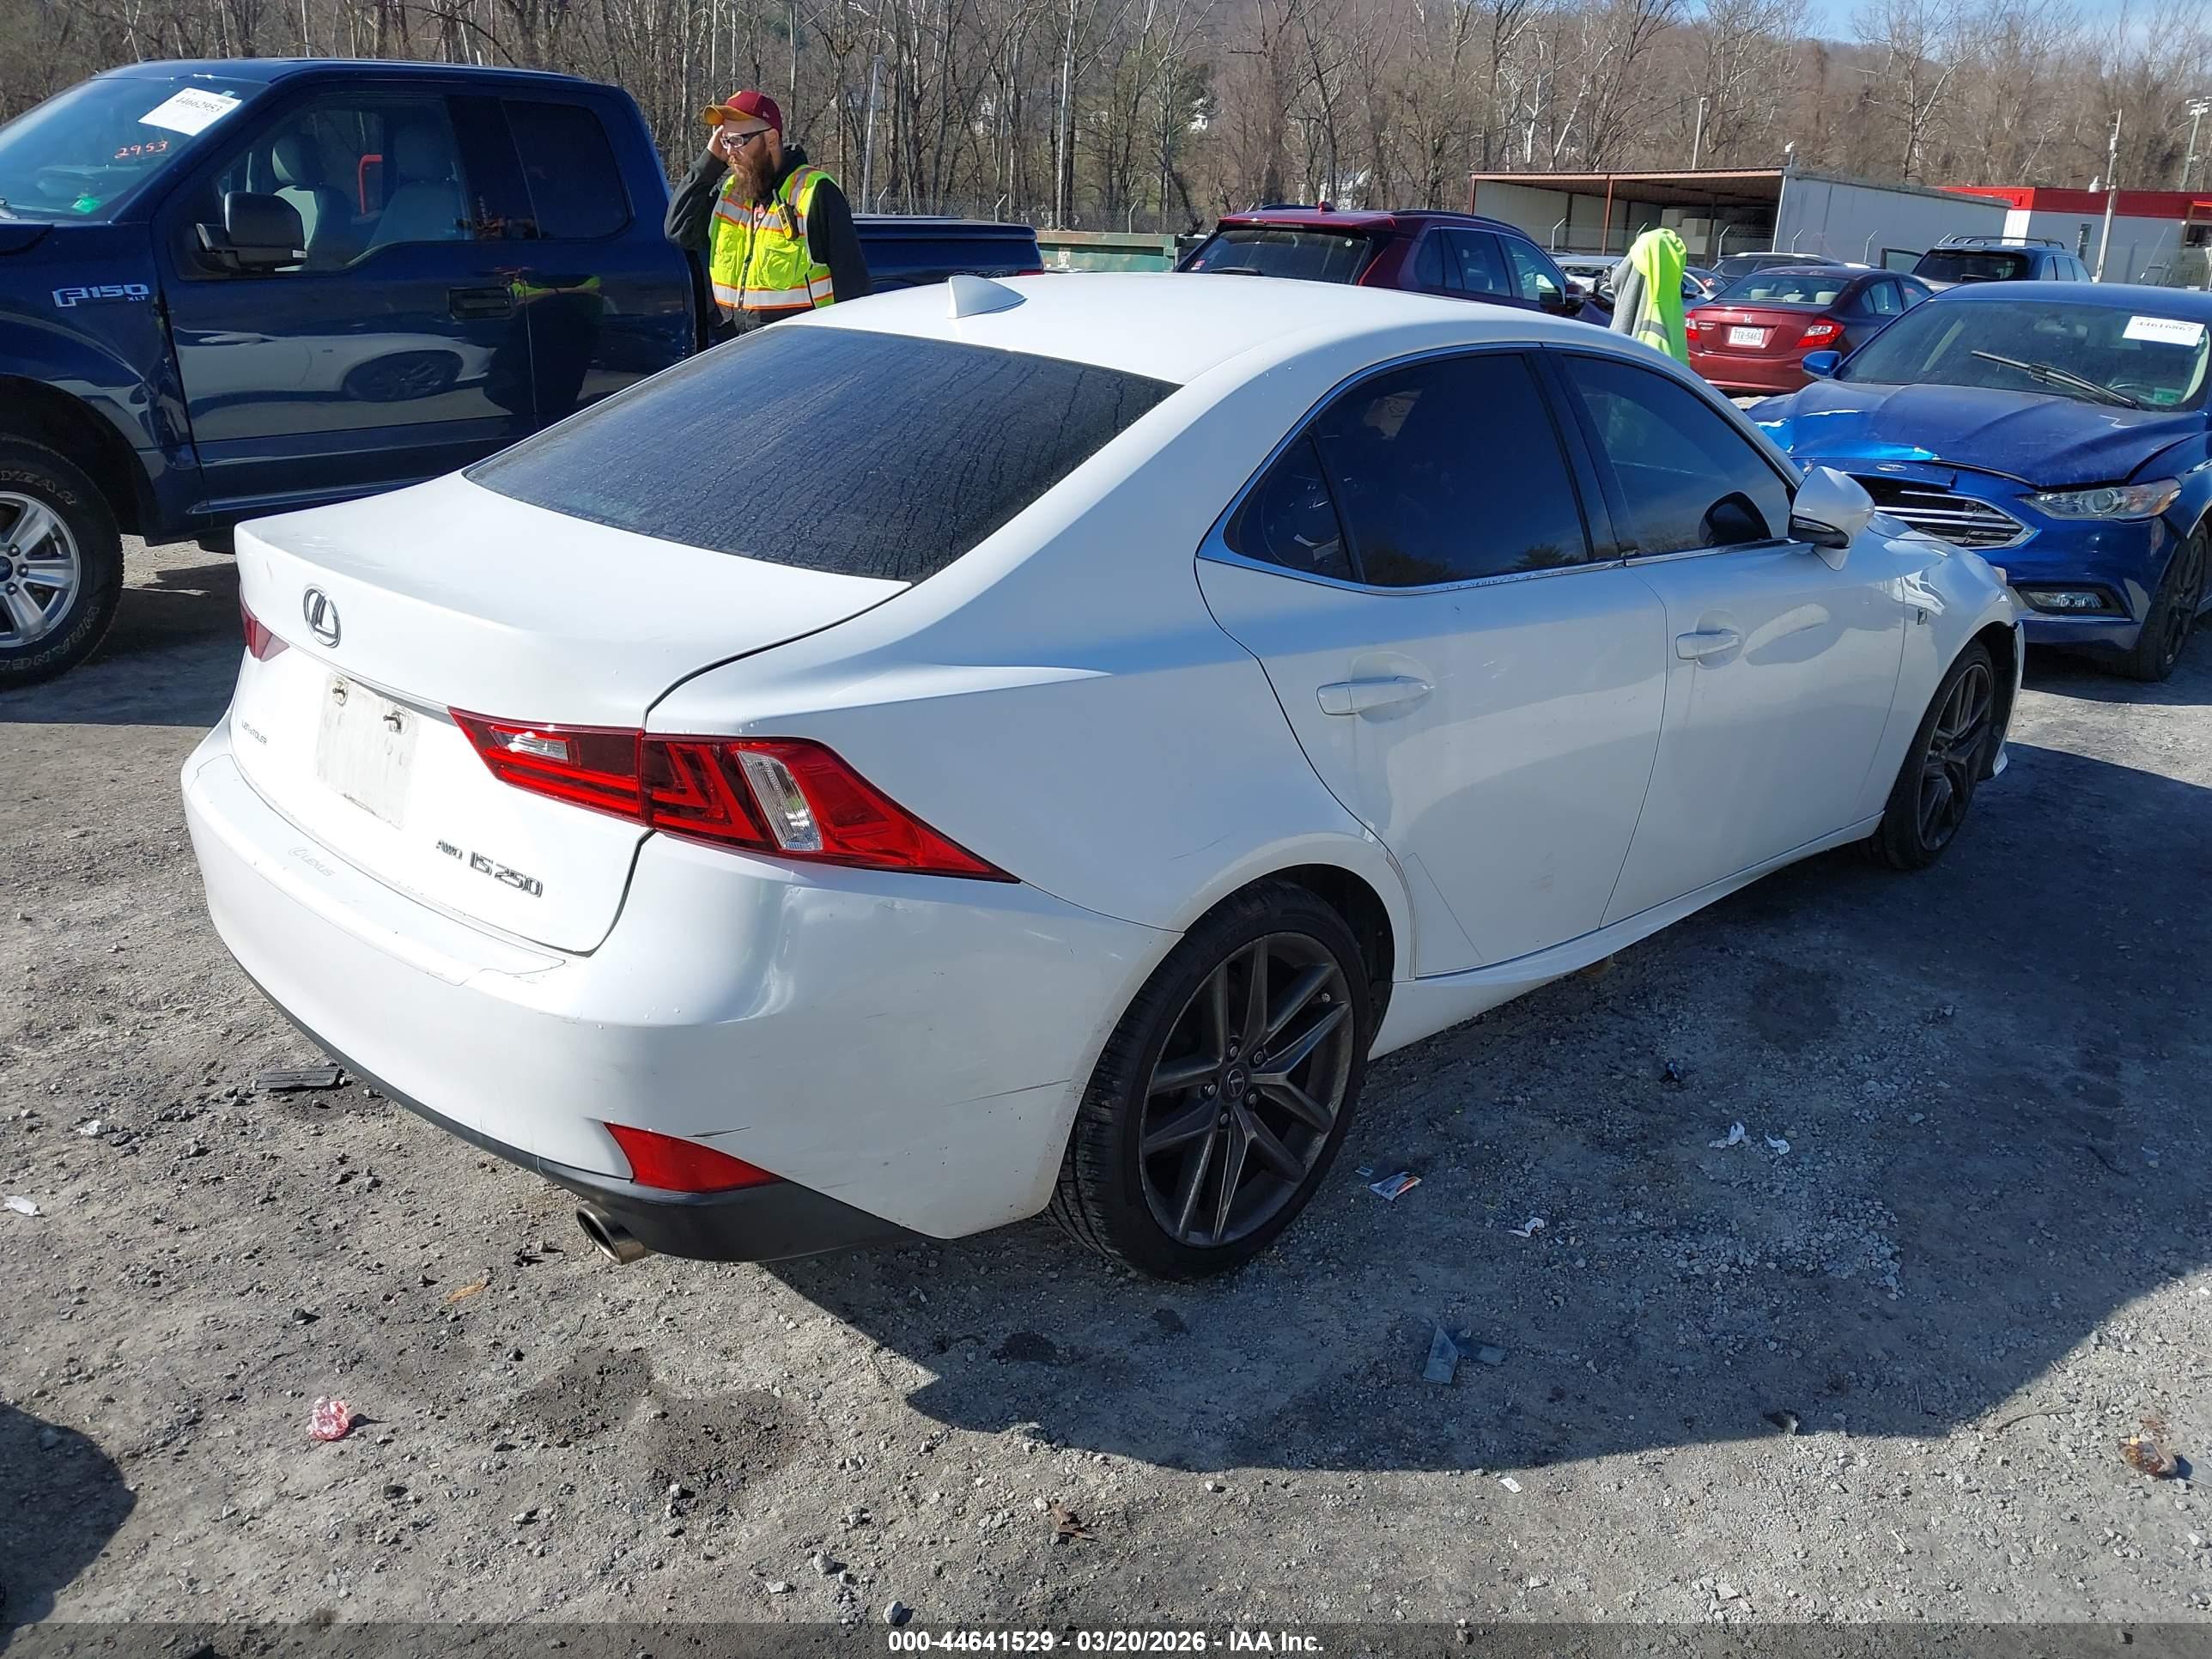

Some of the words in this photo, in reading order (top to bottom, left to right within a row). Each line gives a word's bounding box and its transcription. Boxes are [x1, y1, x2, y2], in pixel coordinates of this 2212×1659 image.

[114, 140, 168, 159] 2953
[435, 839, 463, 860] AWD
[301, 854, 337, 878] LEXUS
[494, 862, 544, 898] 250
